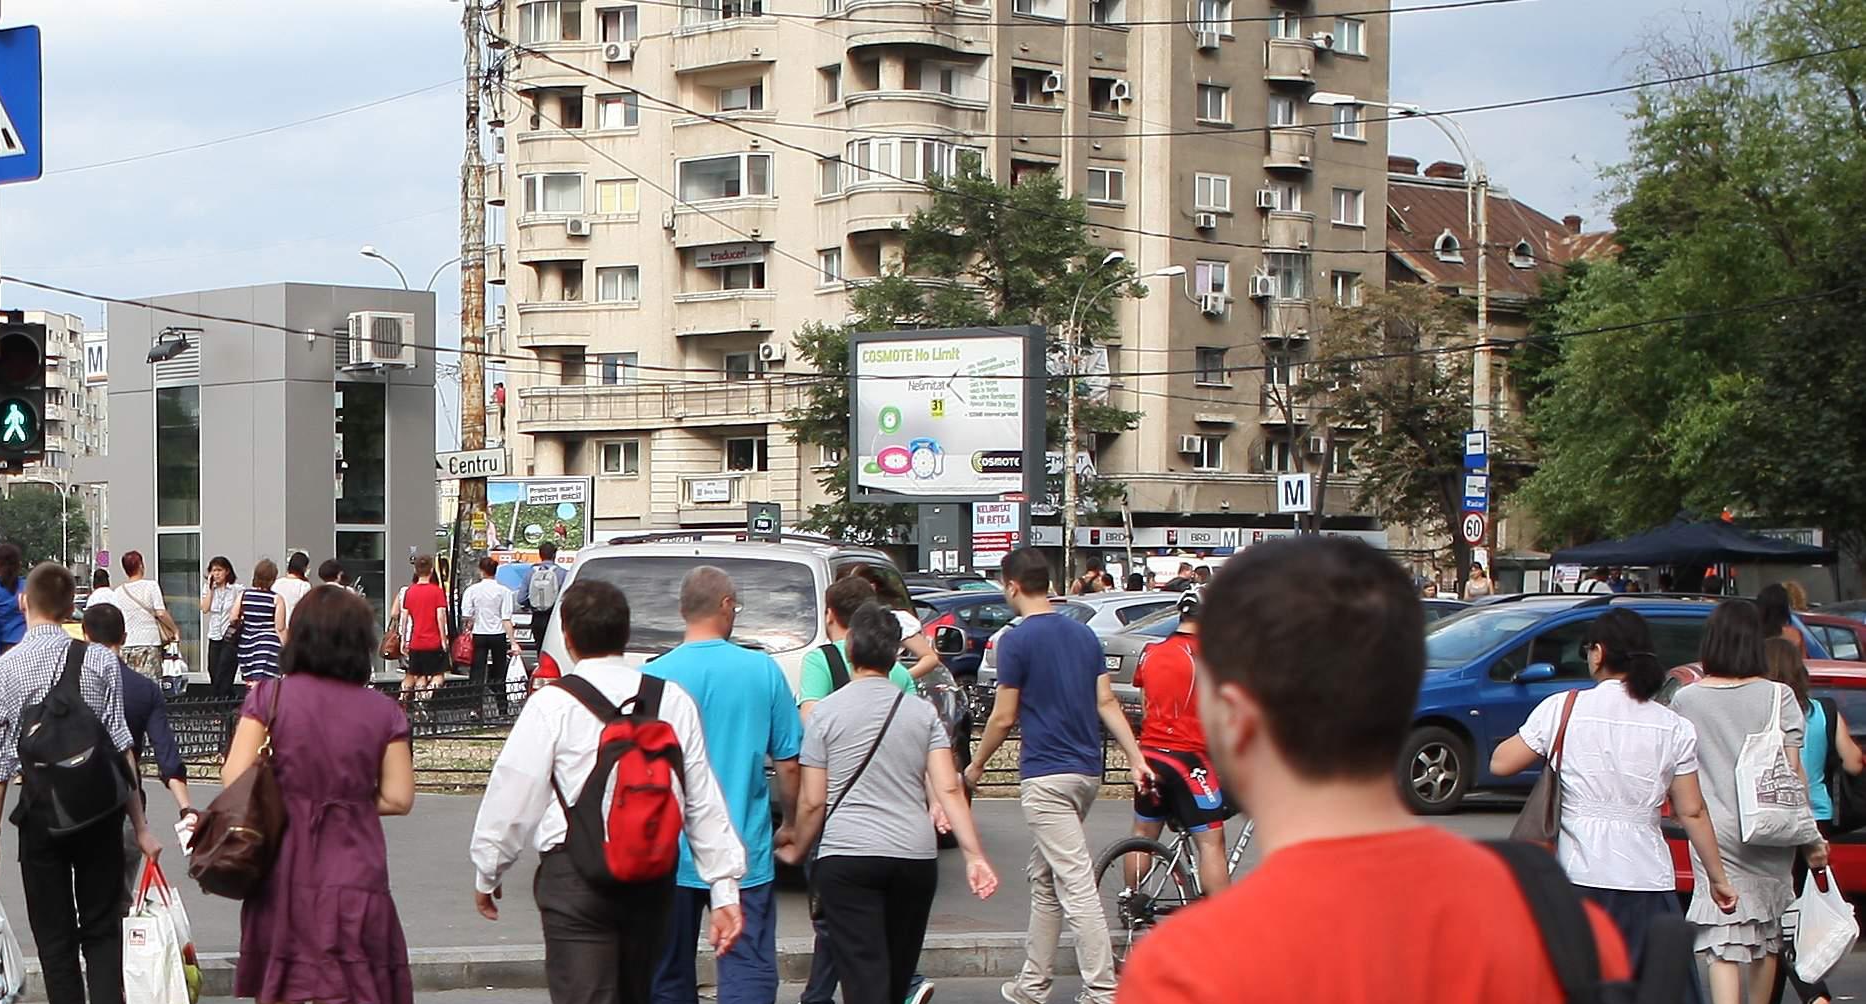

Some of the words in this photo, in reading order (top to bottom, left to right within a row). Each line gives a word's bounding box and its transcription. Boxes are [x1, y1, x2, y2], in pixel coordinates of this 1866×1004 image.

[87, 345, 103, 373] M
[862, 349, 913, 363] COSMOTE
[915, 348, 930, 361] No
[932, 347, 960, 361] Limit
[907, 380, 946, 391] Nelimitat
[931, 400, 943, 411] 31
[449, 456, 498, 475] Centru
[1284, 479, 1304, 506] M
[1466, 519, 1480, 537] 60
[1105, 532, 1126, 541] BRD
[1190, 533, 1211, 542] BRD
[1223, 531, 1235, 547] M
